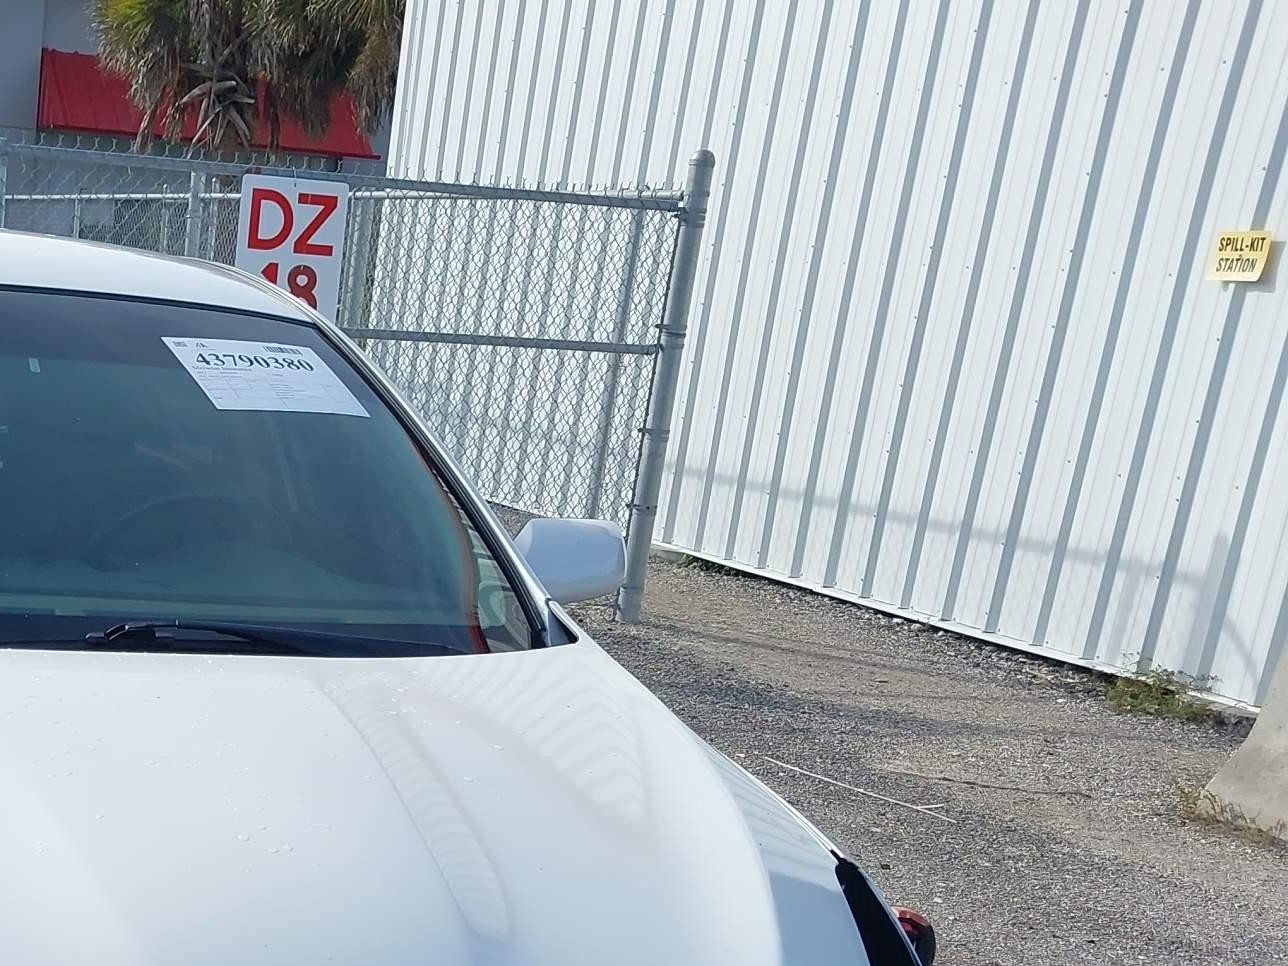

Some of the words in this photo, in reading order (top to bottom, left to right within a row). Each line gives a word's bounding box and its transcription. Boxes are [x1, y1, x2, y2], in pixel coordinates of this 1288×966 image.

[247, 187, 339, 257] DZ
[1218, 237, 1266, 252] SPILL-KIT
[1216, 257, 1258, 272] STATION
[195, 352, 315, 372] 43790380
